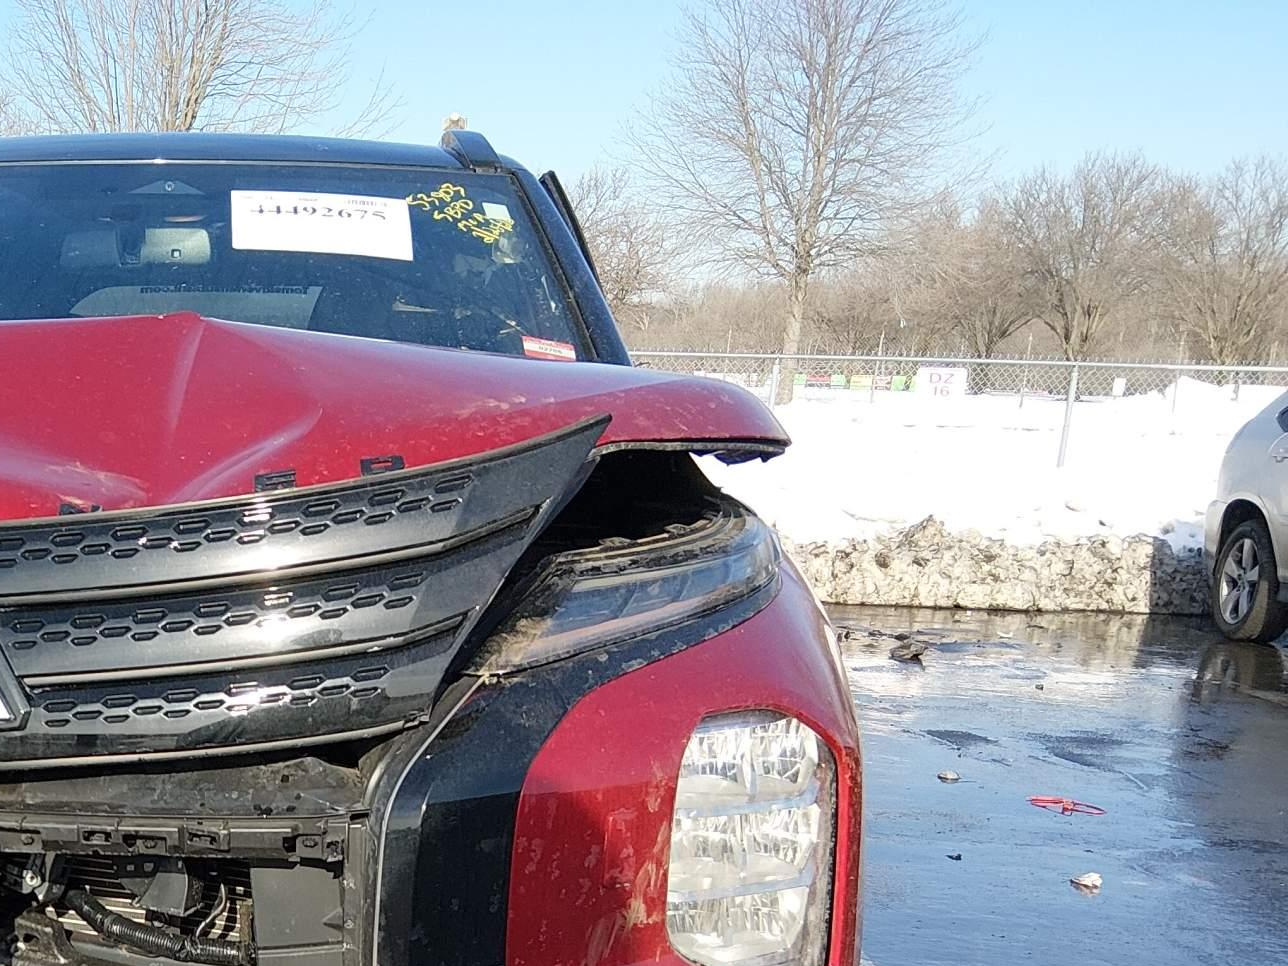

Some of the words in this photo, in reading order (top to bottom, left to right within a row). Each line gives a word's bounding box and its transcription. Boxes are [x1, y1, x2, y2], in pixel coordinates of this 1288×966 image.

[250, 203, 387, 221] 44492675
[928, 372, 955, 385] DZ
[933, 385, 950, 398] 16
